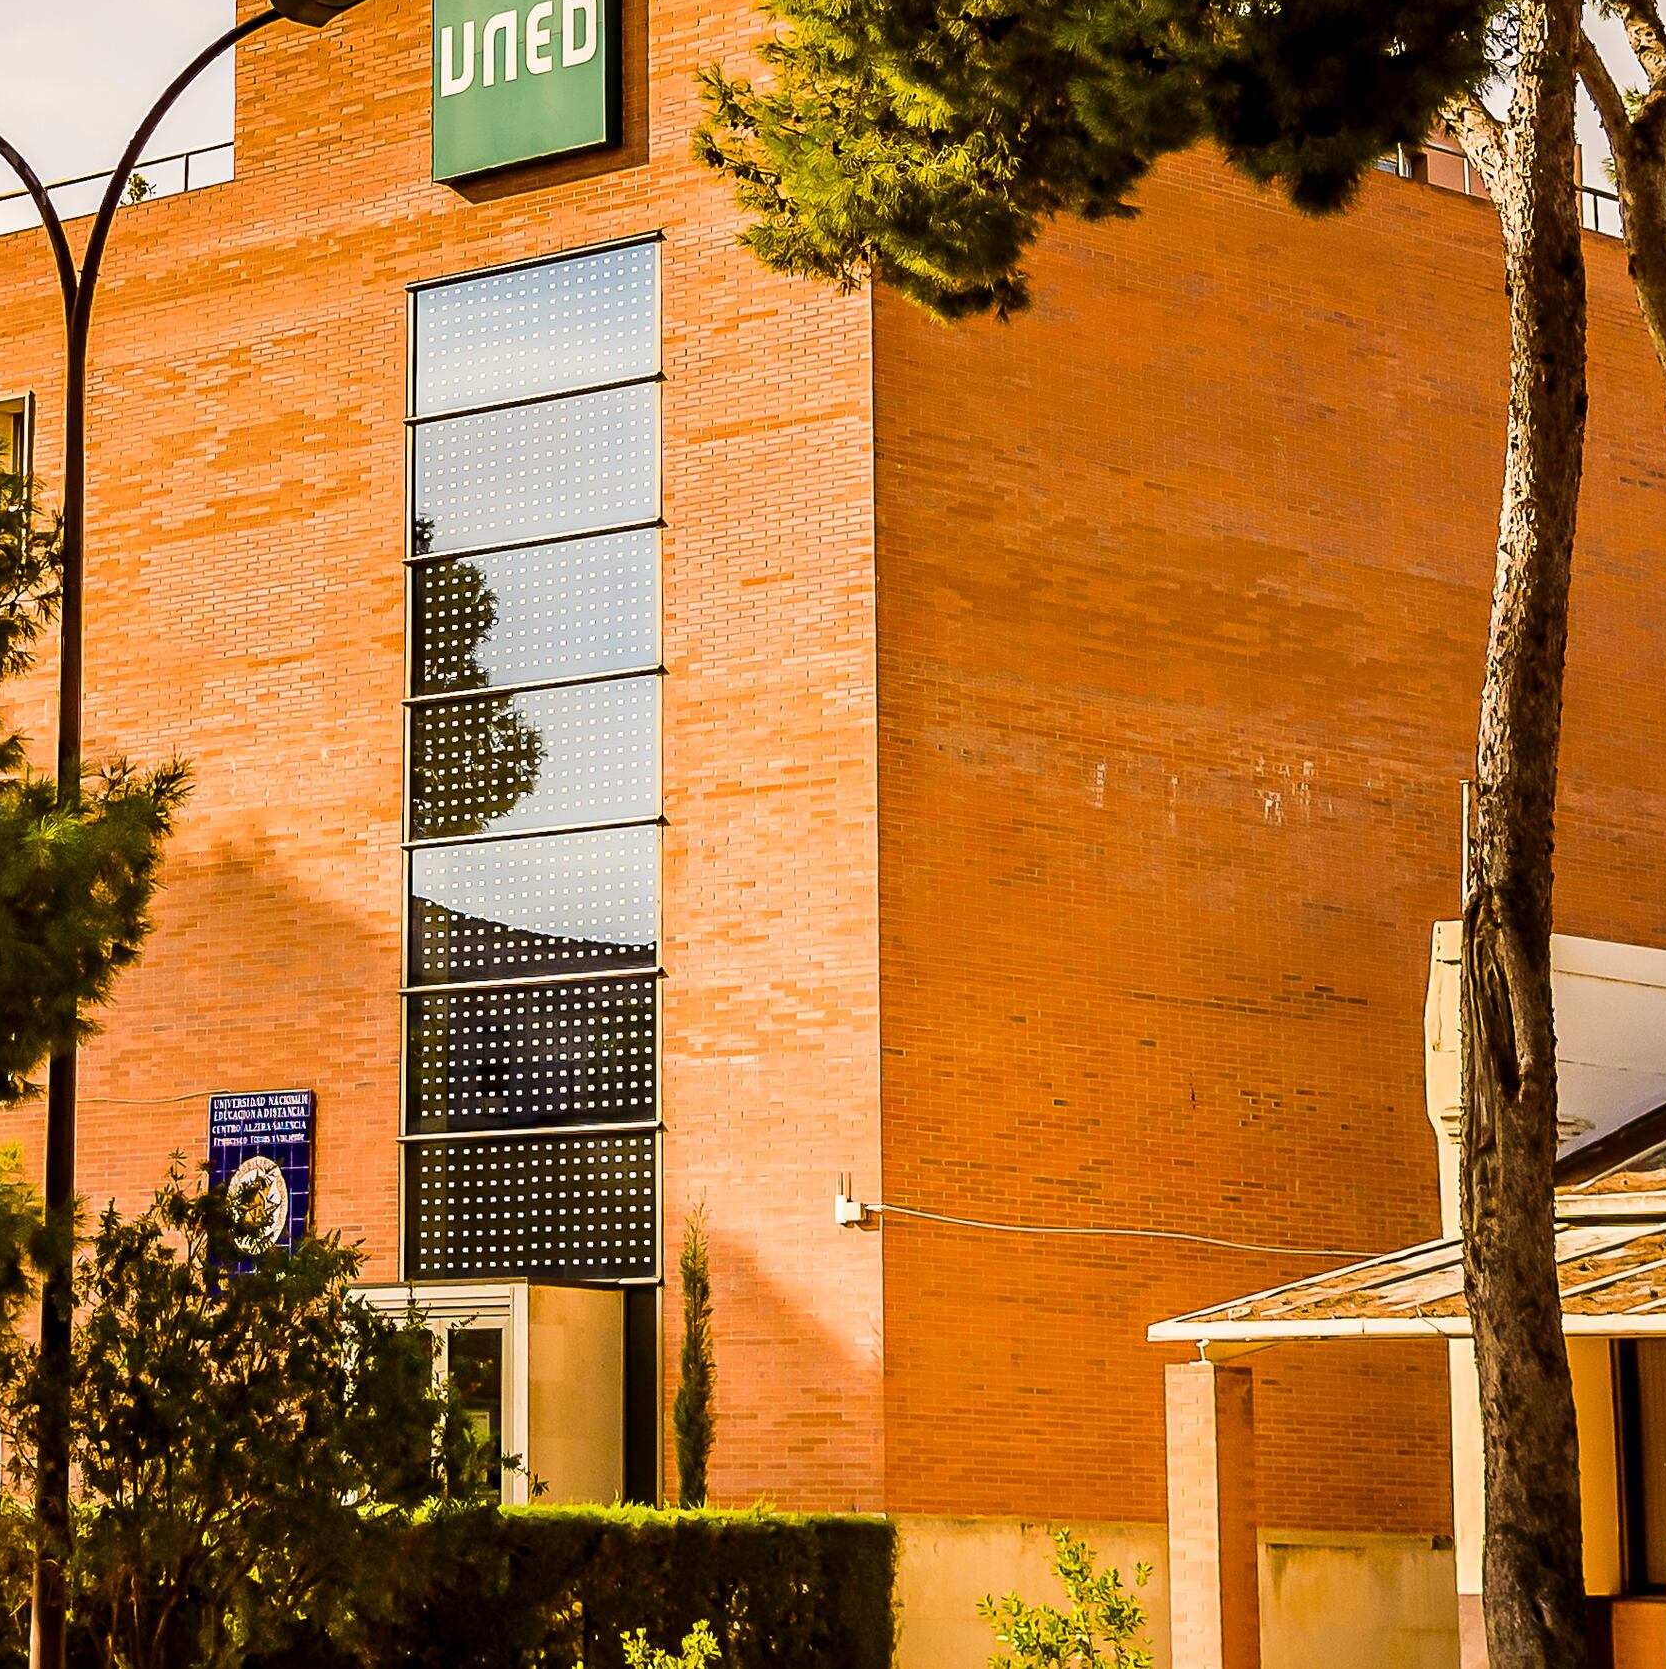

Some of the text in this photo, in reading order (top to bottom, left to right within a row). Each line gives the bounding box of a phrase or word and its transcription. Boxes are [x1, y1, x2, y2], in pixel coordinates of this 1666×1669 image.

[214, 1097, 265, 1109] UNIVERSIDAD
[257, 1108, 263, 1118] A
[264, 1107, 305, 1117] DISTANCIA
[212, 1124, 241, 1134] CENTRO
